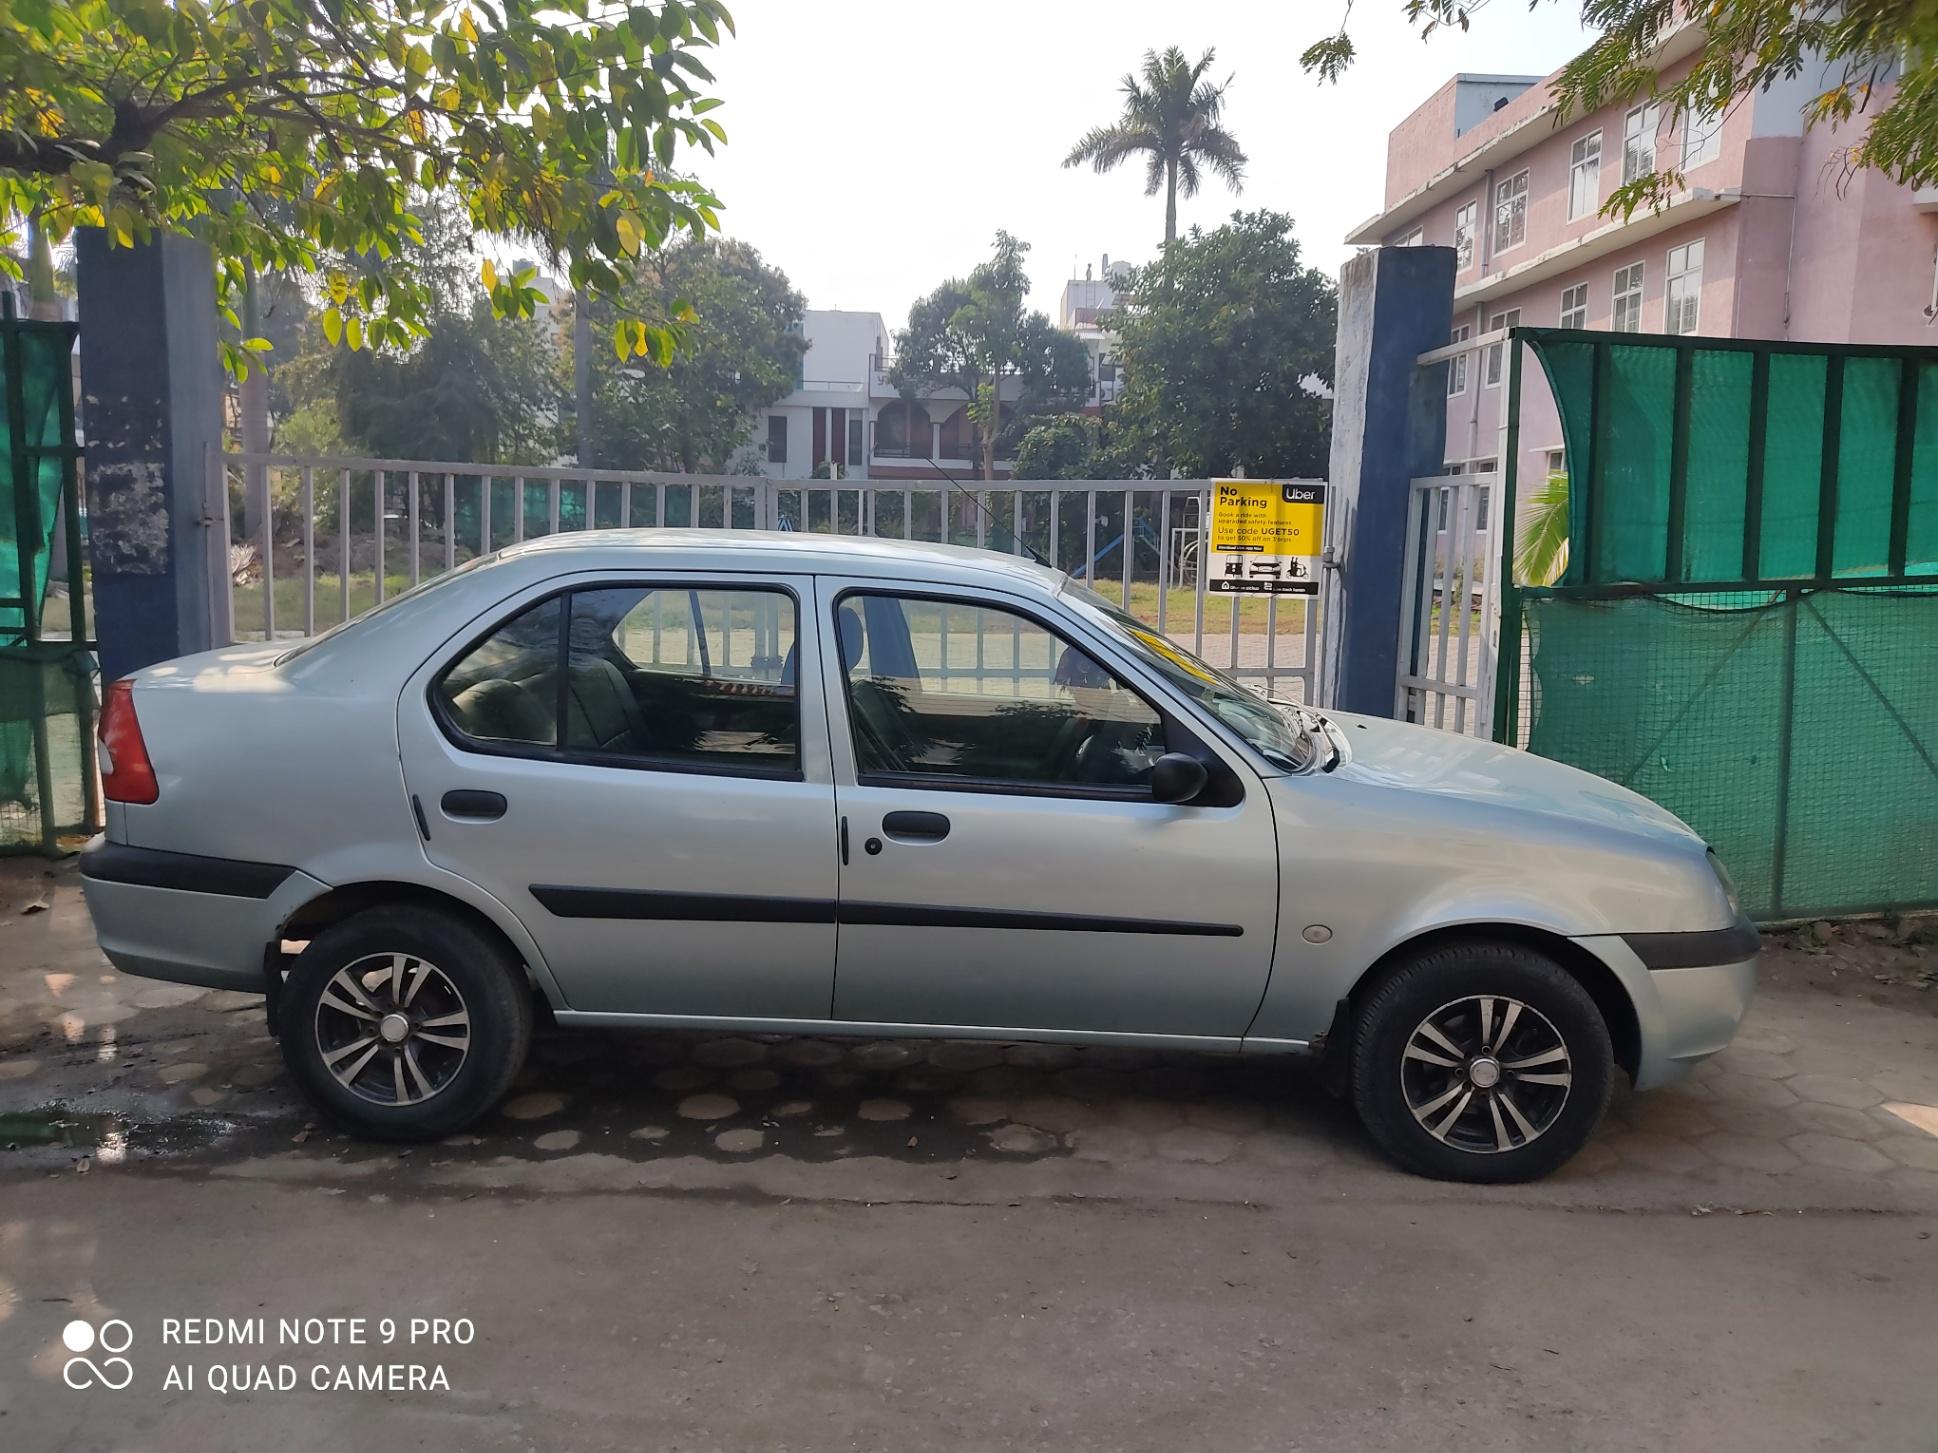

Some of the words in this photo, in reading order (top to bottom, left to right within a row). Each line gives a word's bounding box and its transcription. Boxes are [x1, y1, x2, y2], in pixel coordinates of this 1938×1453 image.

[1220, 486, 1237, 496] No
[1286, 488, 1316, 500] Uber
[1219, 497, 1267, 509] Parking
[1236, 527, 1259, 535] code
[1261, 528, 1300, 536] UGET50
